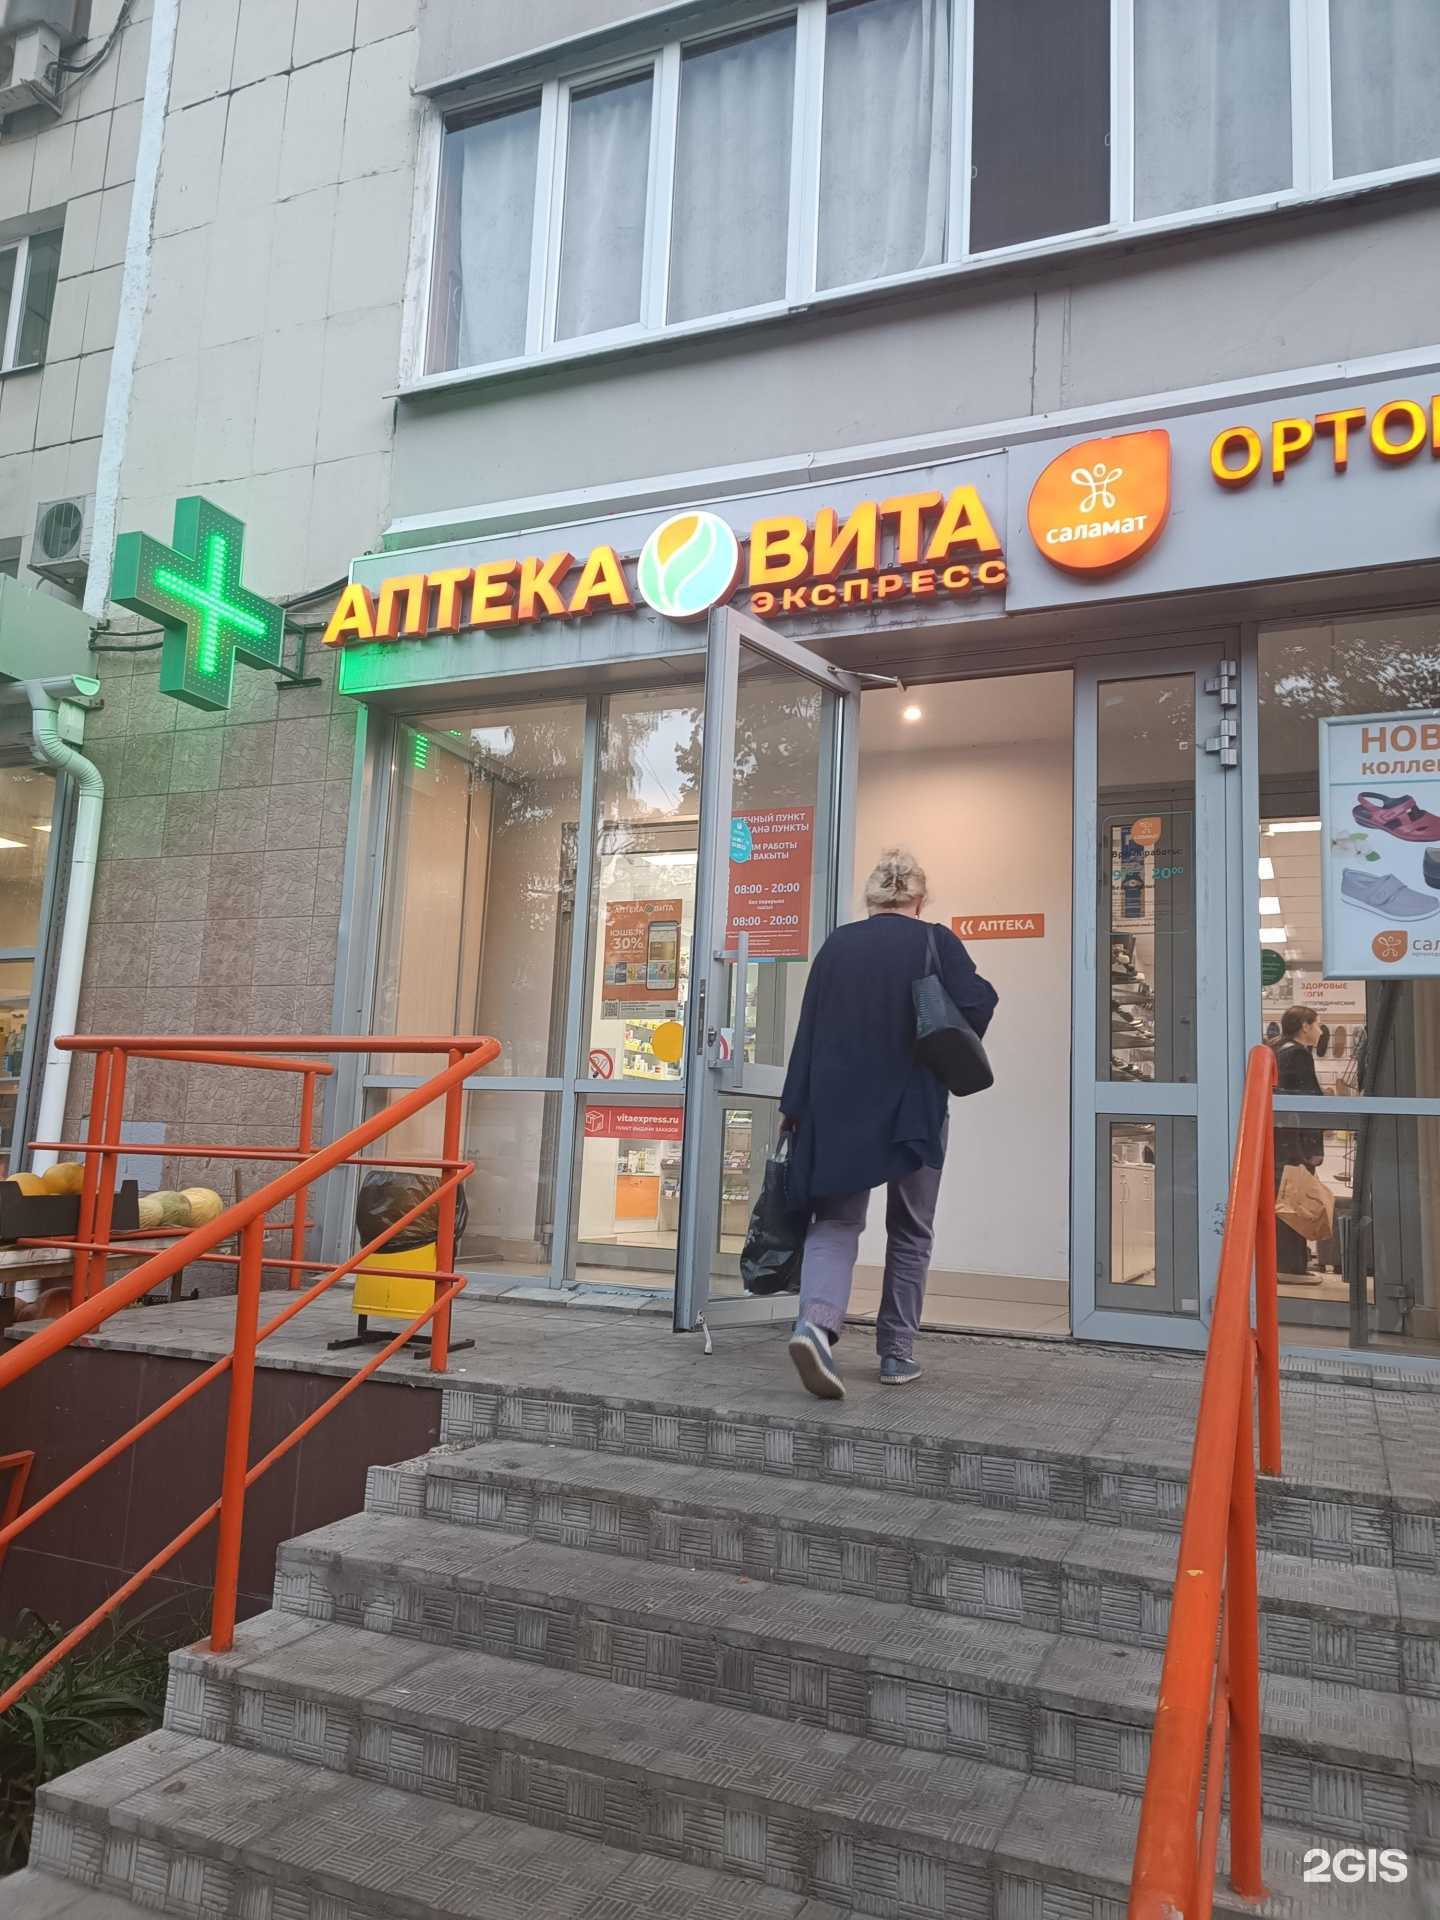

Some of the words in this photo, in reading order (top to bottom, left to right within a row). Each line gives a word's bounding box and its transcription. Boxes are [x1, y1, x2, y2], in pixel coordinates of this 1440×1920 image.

[1046, 514, 1148, 545] саламат
[321, 544, 635, 648] АПТЕКА
[748, 483, 1004, 590] ВИТА
[750, 559, 1008, 617] ЭКСПРЕСС
[775, 812, 806, 821] ПУНКТ
[762, 842, 798, 850] РАБОТЫ
[734, 884, 762, 895] 08:00
[771, 882, 800, 893] 20:00
[732, 916, 761, 927] 08:00
[769, 914, 799, 925] 20:00
[977, 919, 1035, 932] АПТЕКА
[616, 1113, 679, 1125] vitaexpress.ru
